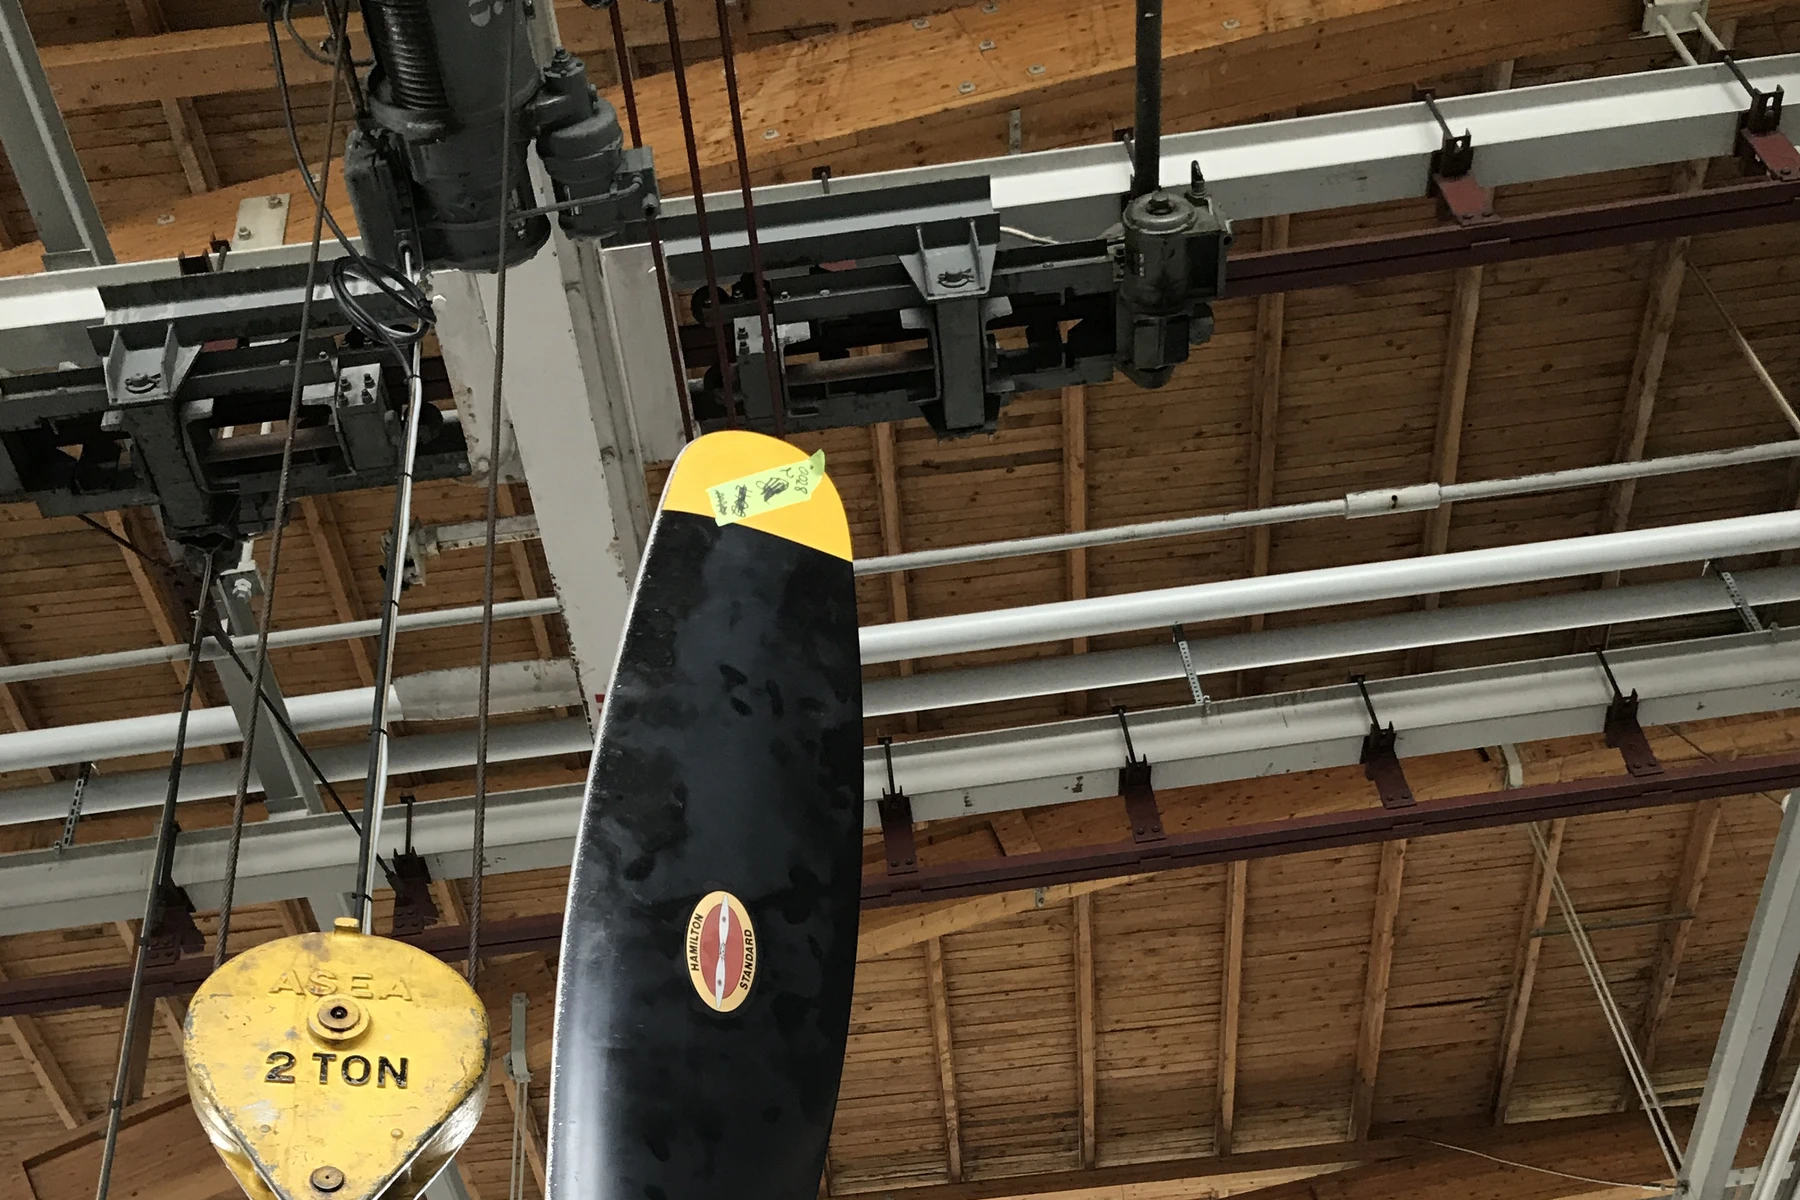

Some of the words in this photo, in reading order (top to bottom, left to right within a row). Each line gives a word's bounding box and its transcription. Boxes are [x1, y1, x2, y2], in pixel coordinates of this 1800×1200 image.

[689, 913, 704, 972] HAMILTON
[739, 929, 755, 991] STANDARD
[269, 969, 413, 1001] ASEA
[264, 1051, 296, 1084] 2
[312, 1052, 410, 1089] TON
